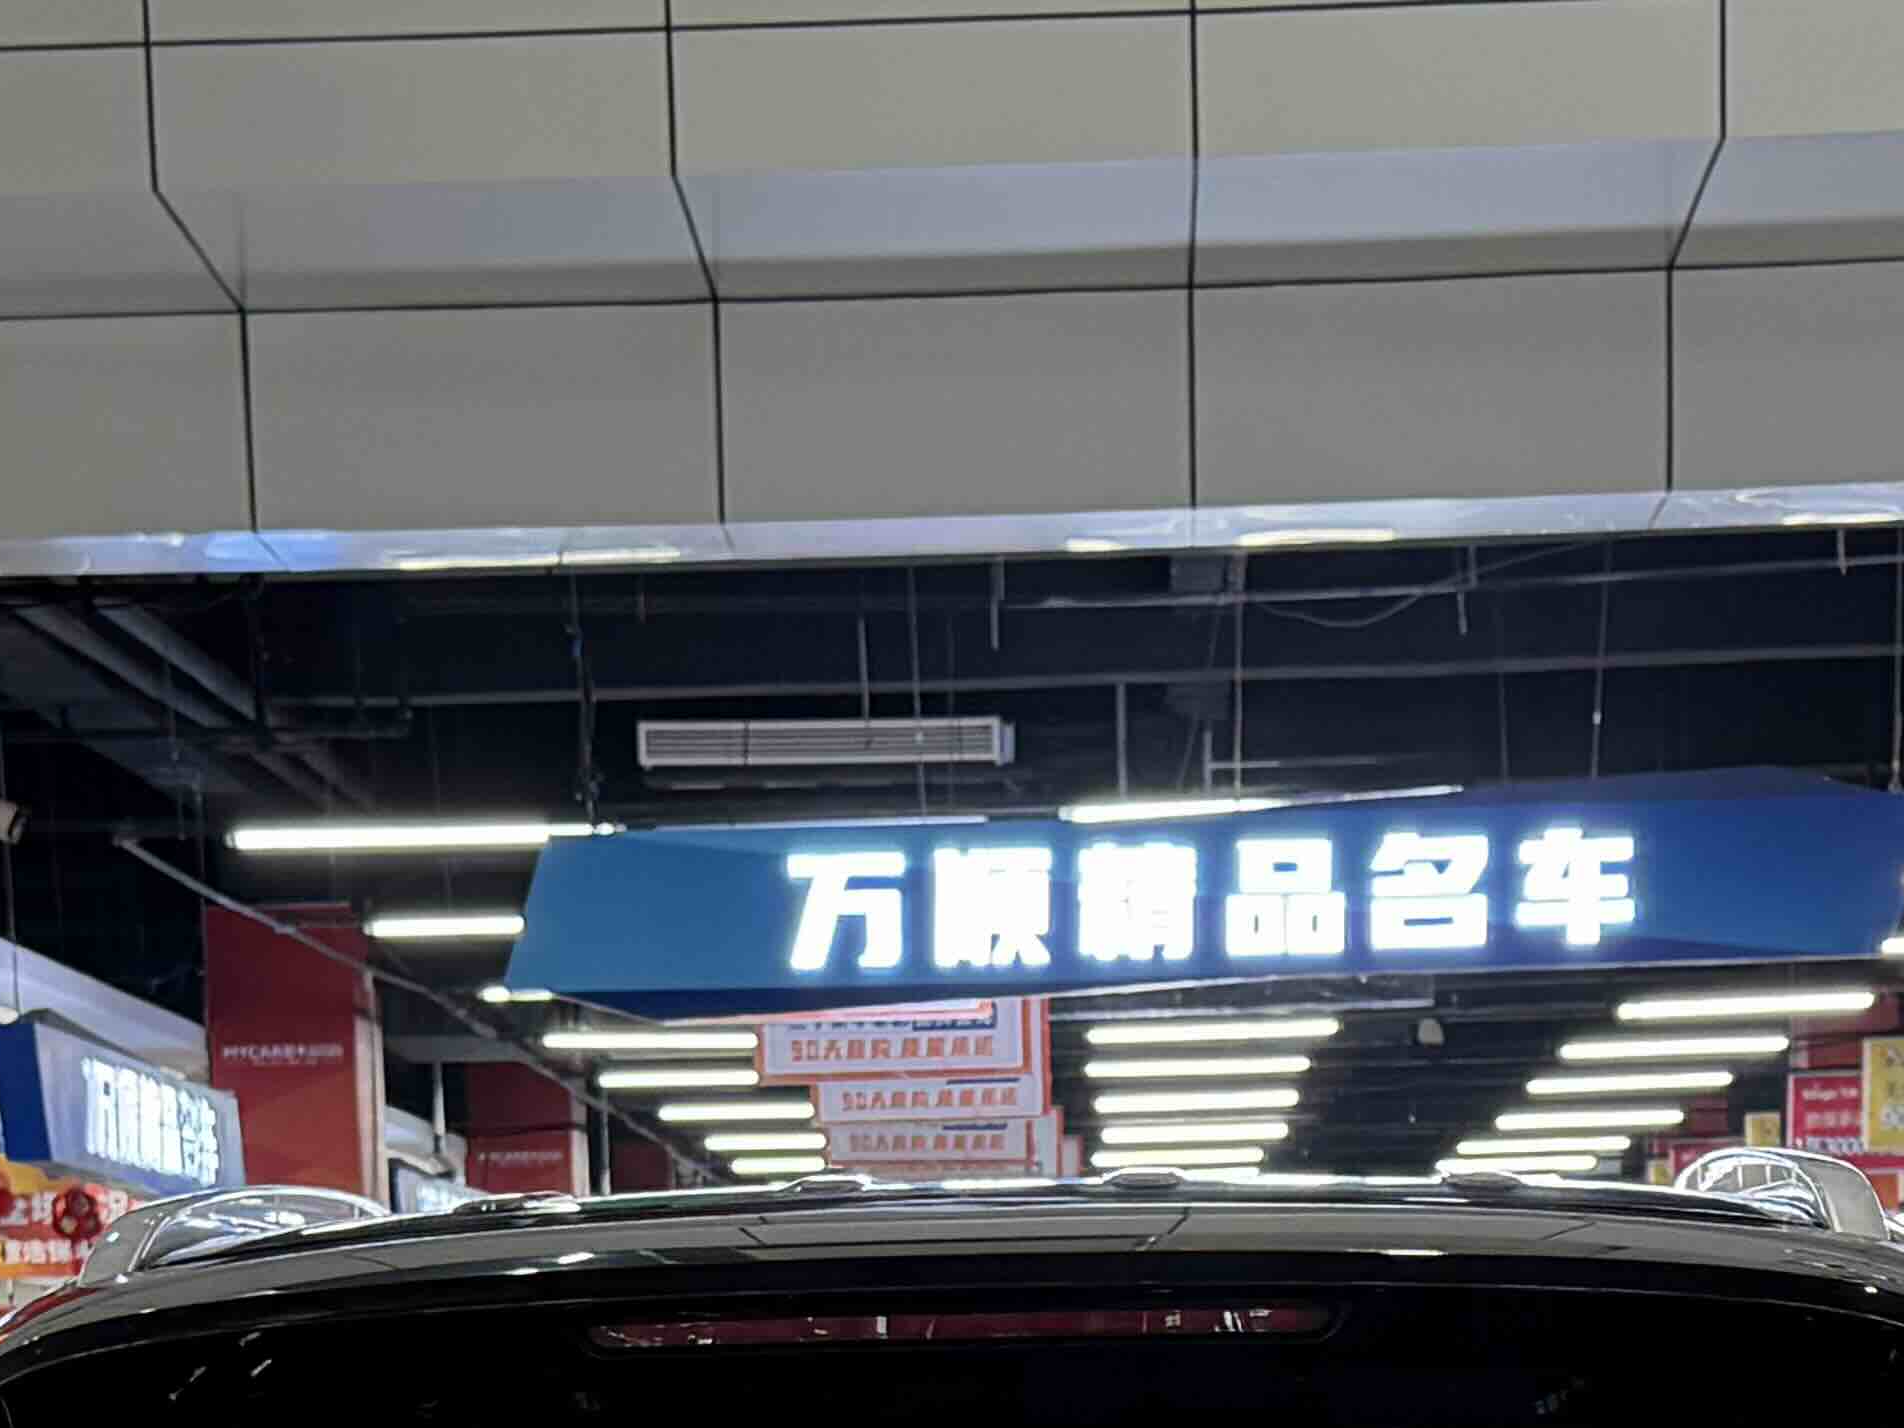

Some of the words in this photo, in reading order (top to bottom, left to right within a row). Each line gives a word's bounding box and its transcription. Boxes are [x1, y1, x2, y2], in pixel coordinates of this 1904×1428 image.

[786, 828, 1637, 972] 万顺精品名车
